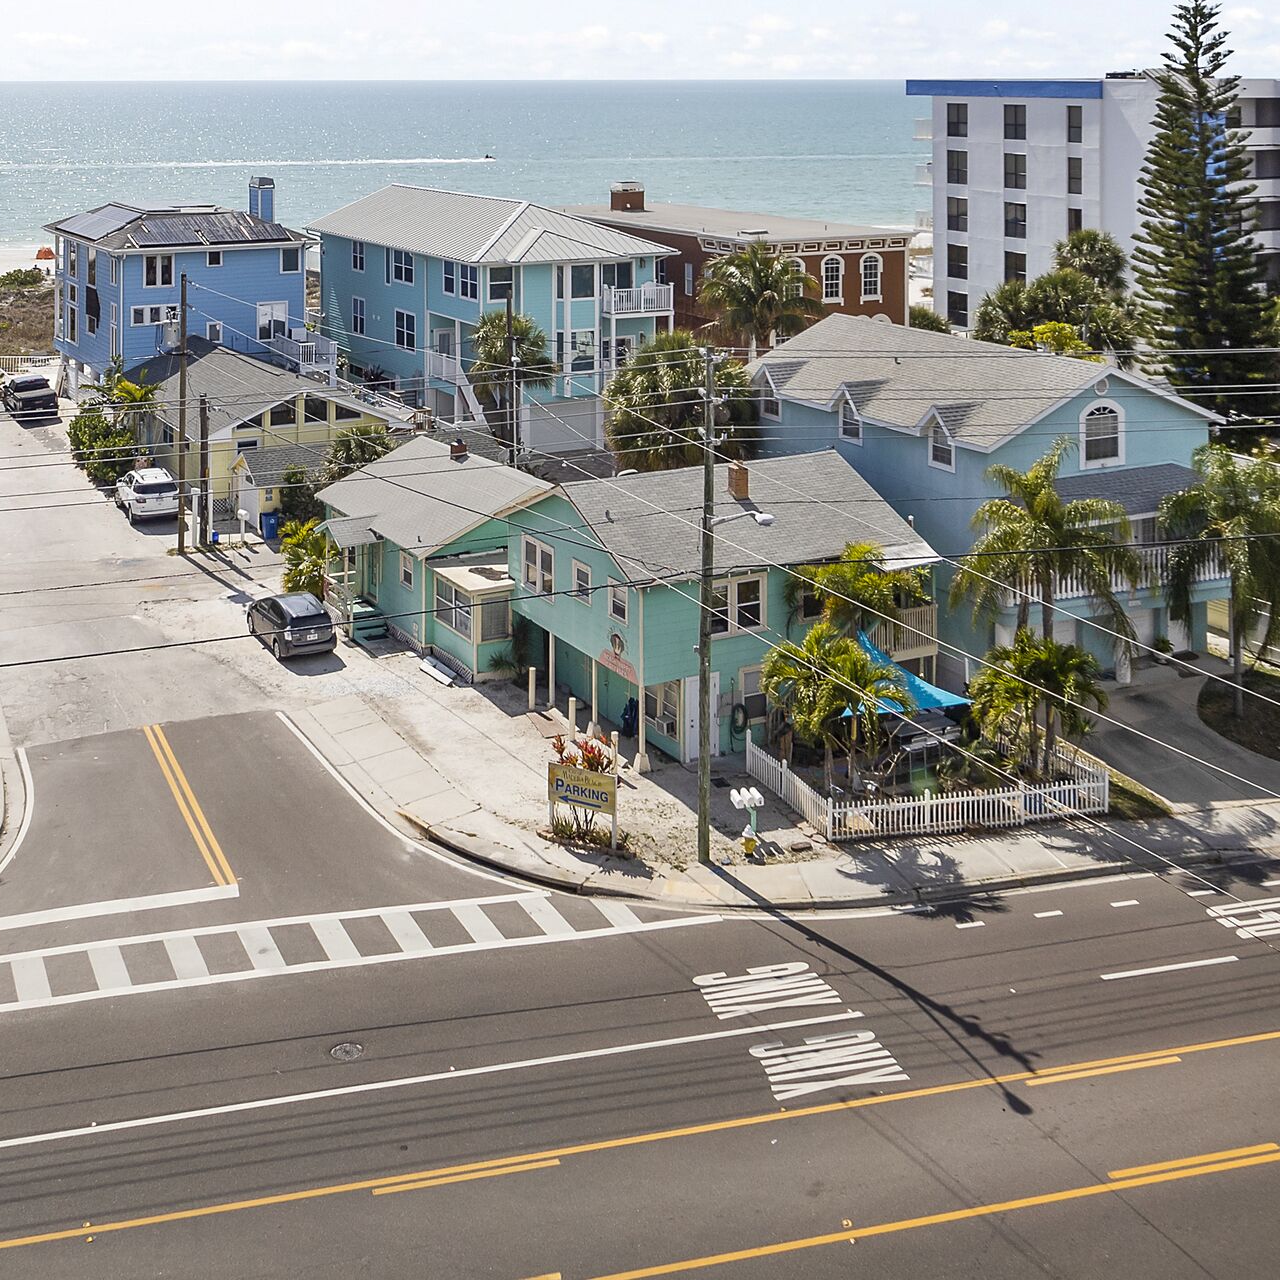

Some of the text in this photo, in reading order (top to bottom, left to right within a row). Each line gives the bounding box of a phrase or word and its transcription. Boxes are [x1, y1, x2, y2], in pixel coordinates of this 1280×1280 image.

[555, 777, 609, 803] PARKING
[692, 961, 842, 1020] XING
[748, 1029, 911, 1101] XING
